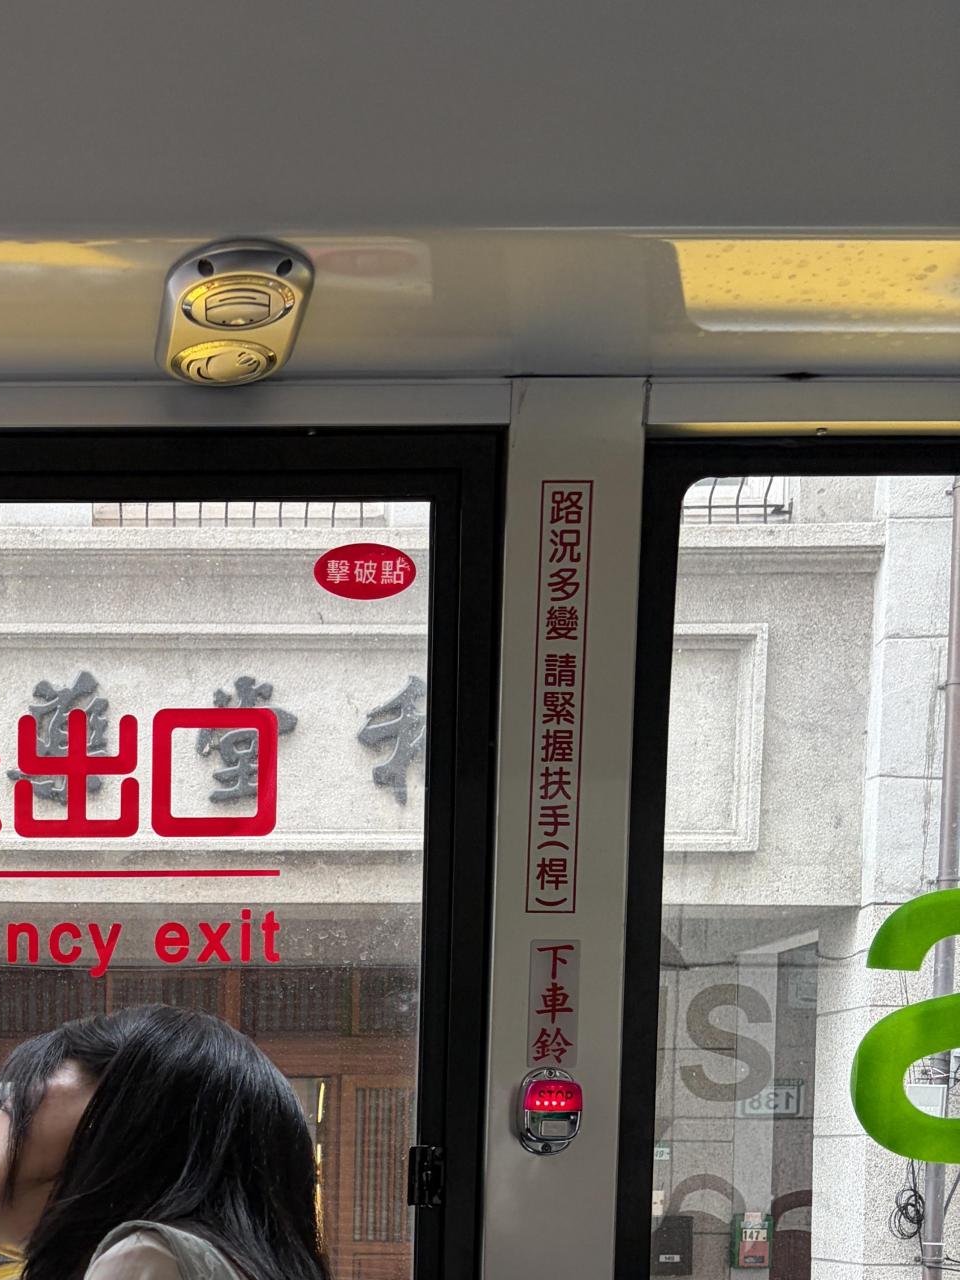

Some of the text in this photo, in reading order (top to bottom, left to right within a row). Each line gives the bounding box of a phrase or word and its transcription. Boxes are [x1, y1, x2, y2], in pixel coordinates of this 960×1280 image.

[326, 559, 405, 585] 擊破點
[545, 490, 584, 641] 路況多變
[155, 909, 281, 963] exit
[532, 944, 575, 1064] 下車鈴
[538, 1089, 574, 1101] STOP
